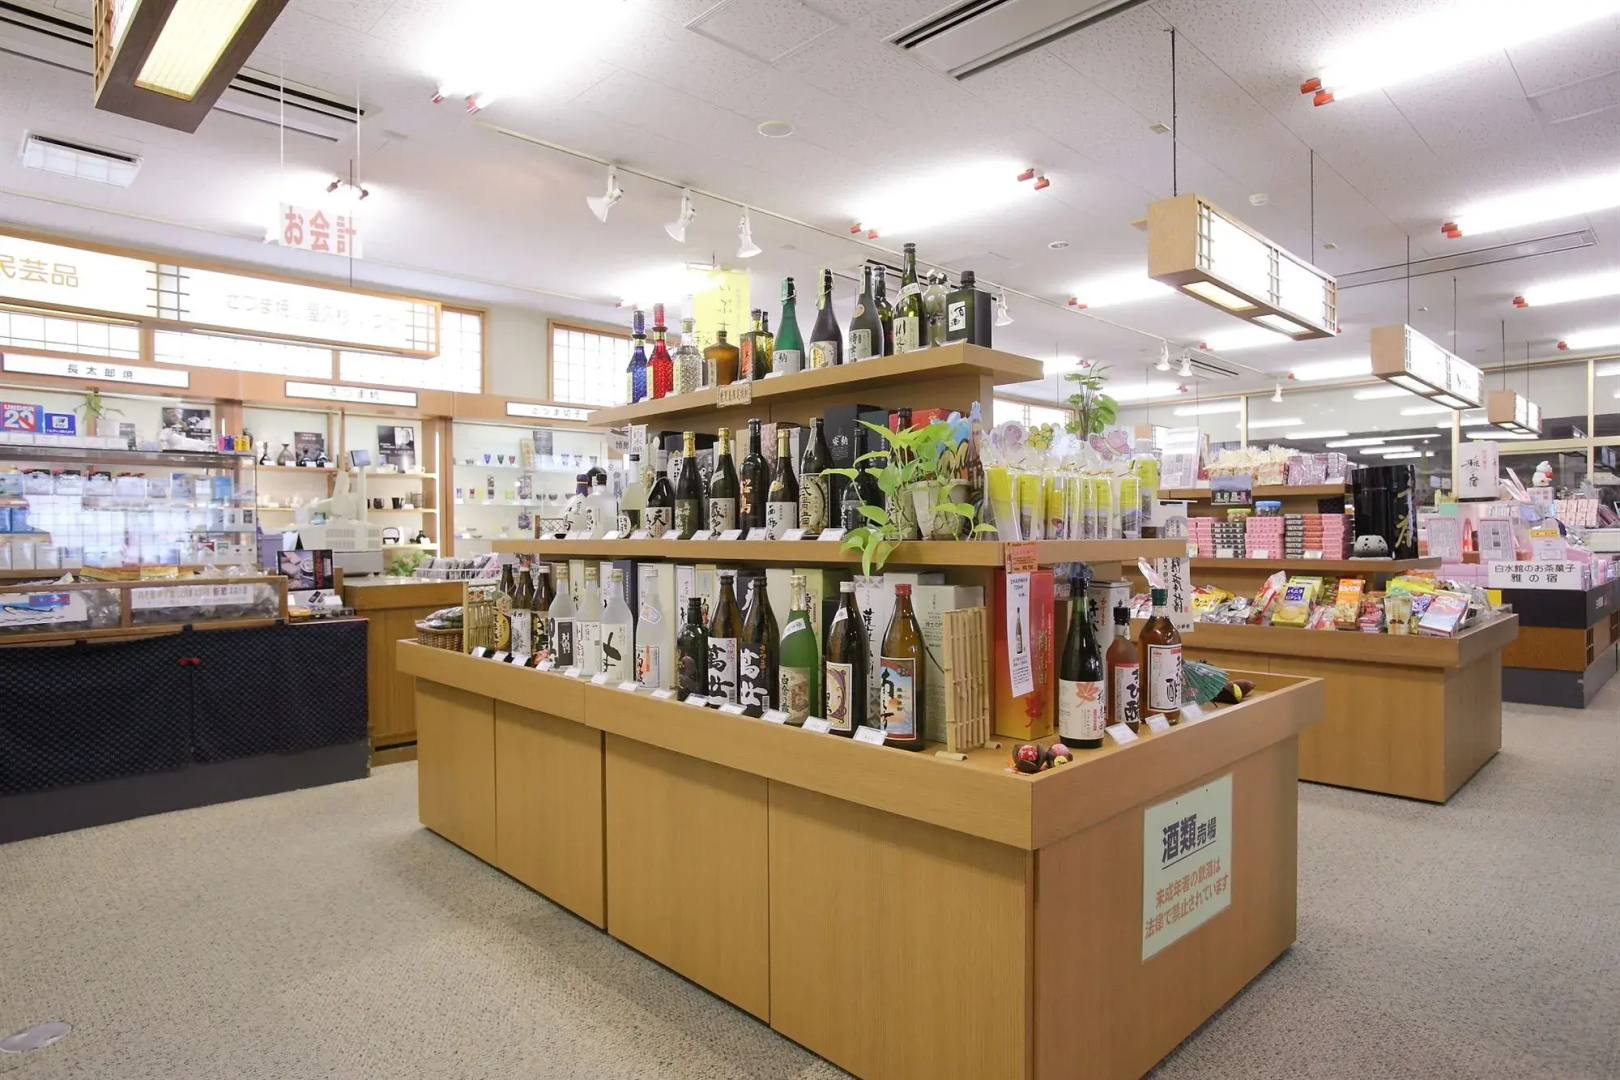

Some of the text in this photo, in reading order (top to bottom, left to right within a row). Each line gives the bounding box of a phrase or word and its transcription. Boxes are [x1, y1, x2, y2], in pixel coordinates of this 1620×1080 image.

[284, 204, 357, 254] お会計
[4, 404, 35, 412] UNDER
[4, 409, 35, 429] 20
[1494, 563, 1576, 573] 白水館のお茶菓子
[1161, 813, 1217, 864] 酒類売場
[1145, 873, 1229, 940] 法律で禁止されています
[1155, 856, 1221, 909] 未成年者の飲酒は
